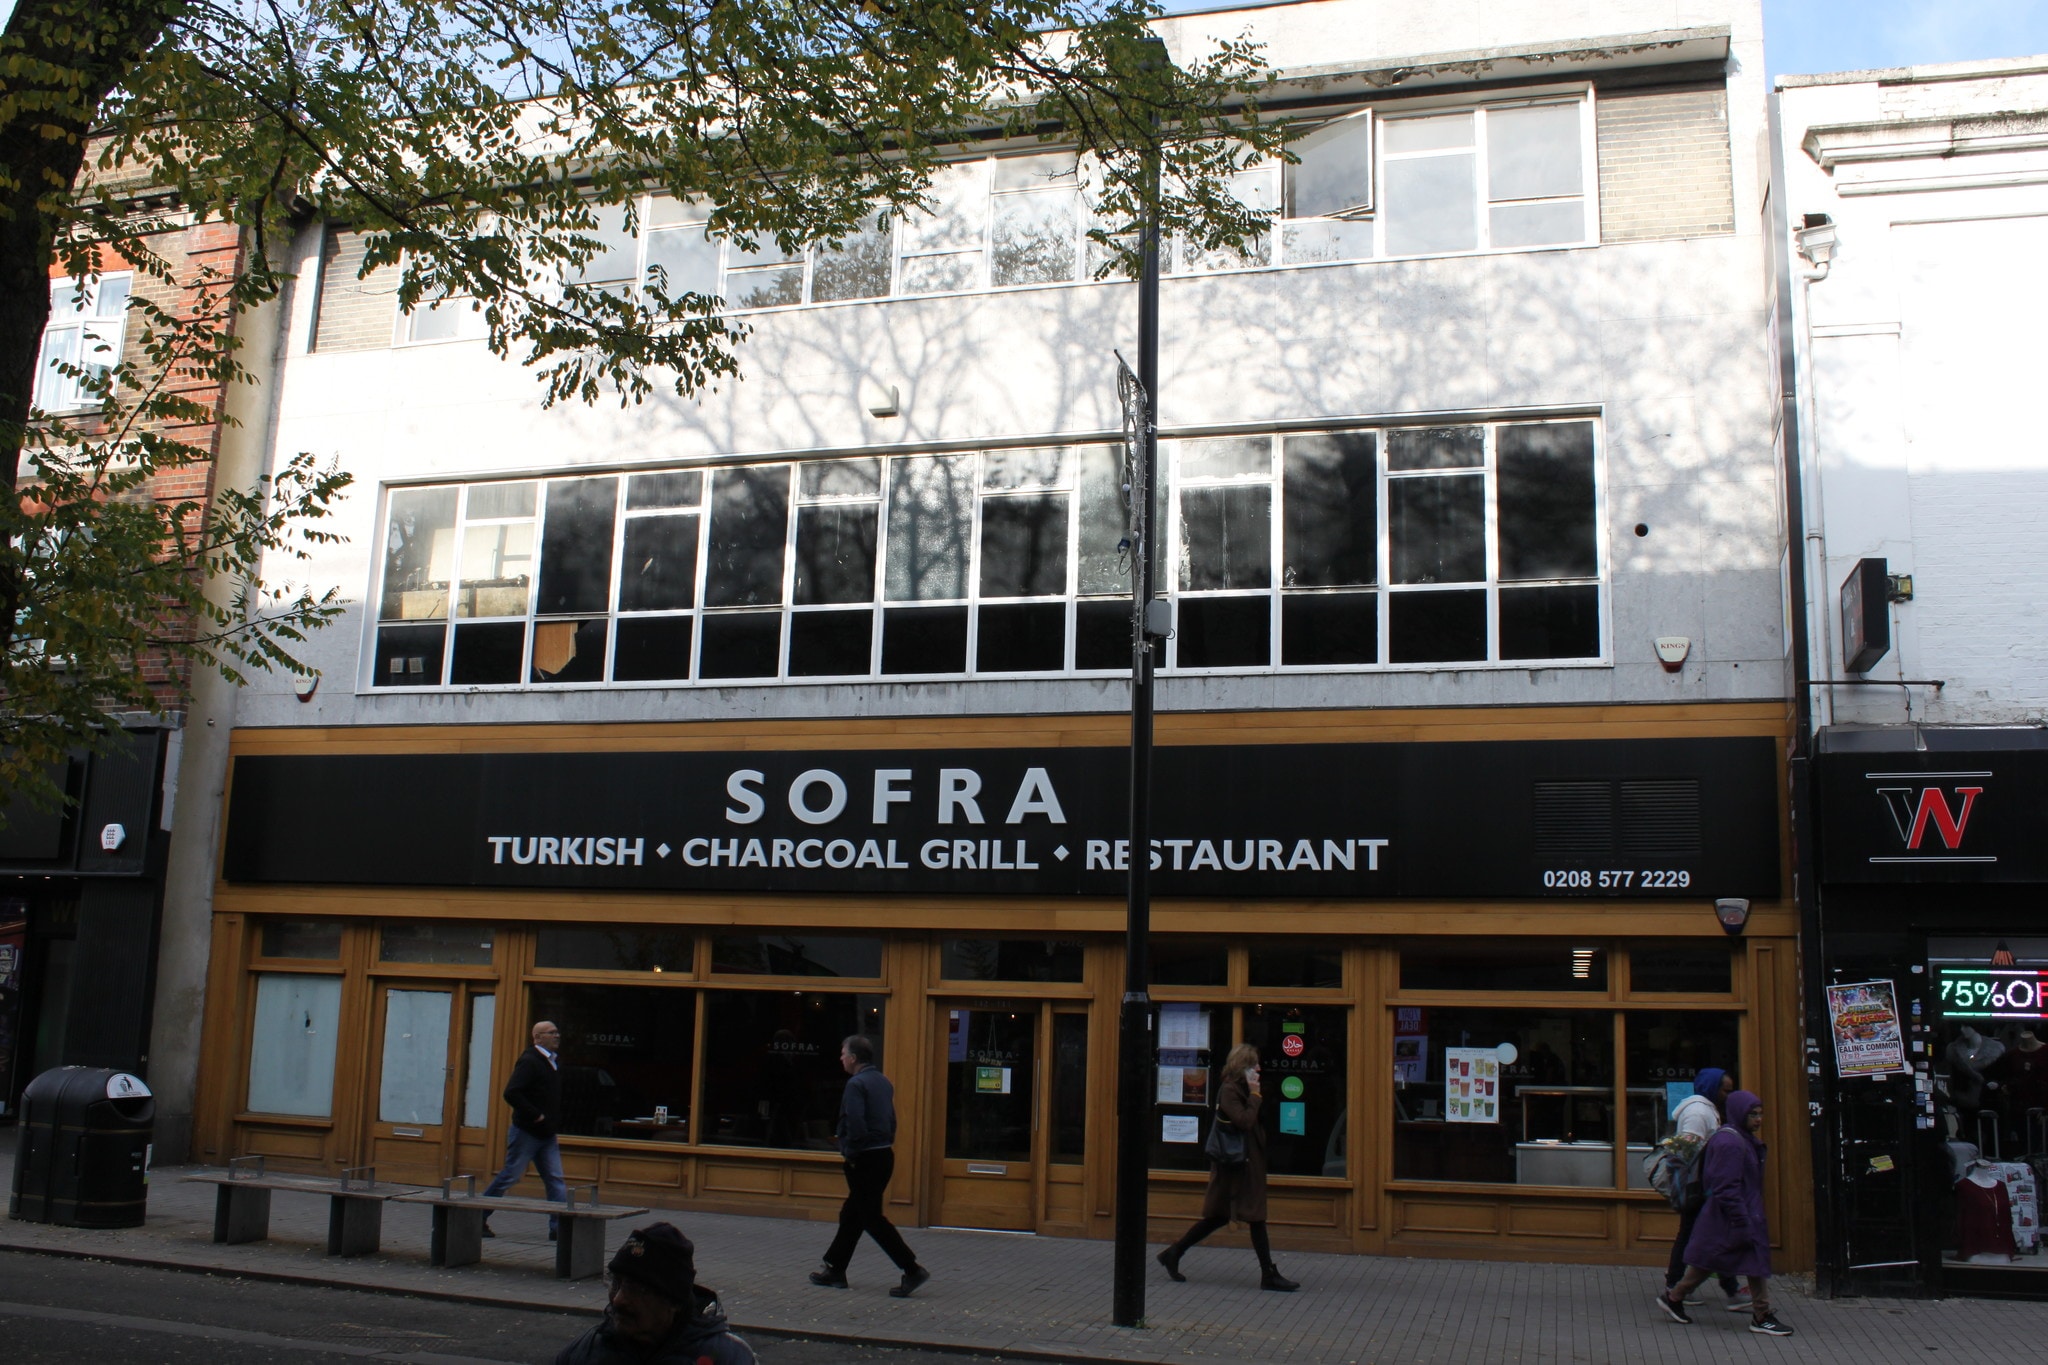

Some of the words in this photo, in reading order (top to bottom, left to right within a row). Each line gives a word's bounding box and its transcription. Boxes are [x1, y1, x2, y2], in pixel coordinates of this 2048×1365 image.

[725, 767, 1067, 825] SOFRA
[487, 836, 645, 866] TURKISH
[682, 837, 909, 869] CHARCOAL
[920, 839, 1039, 870] GRILL
[1086, 838, 1389, 871] RESTAURANT
[1543, 870, 1592, 889] 0208
[1598, 870, 1635, 889] 577
[1641, 870, 1691, 889] 2229
[591, 1033, 631, 1043] SOFRA
[771, 1041, 815, 1052] SOFRA
[1839, 1044, 1864, 1054] EALING
[1866, 1041, 1898, 1051] COMMON
[968, 1048, 1013, 1059] SOFRA
[979, 1056, 1002, 1066] OPEN
[1271, 1059, 1319, 1069] SOFRA
[1655, 1066, 1696, 1078] SOFR
